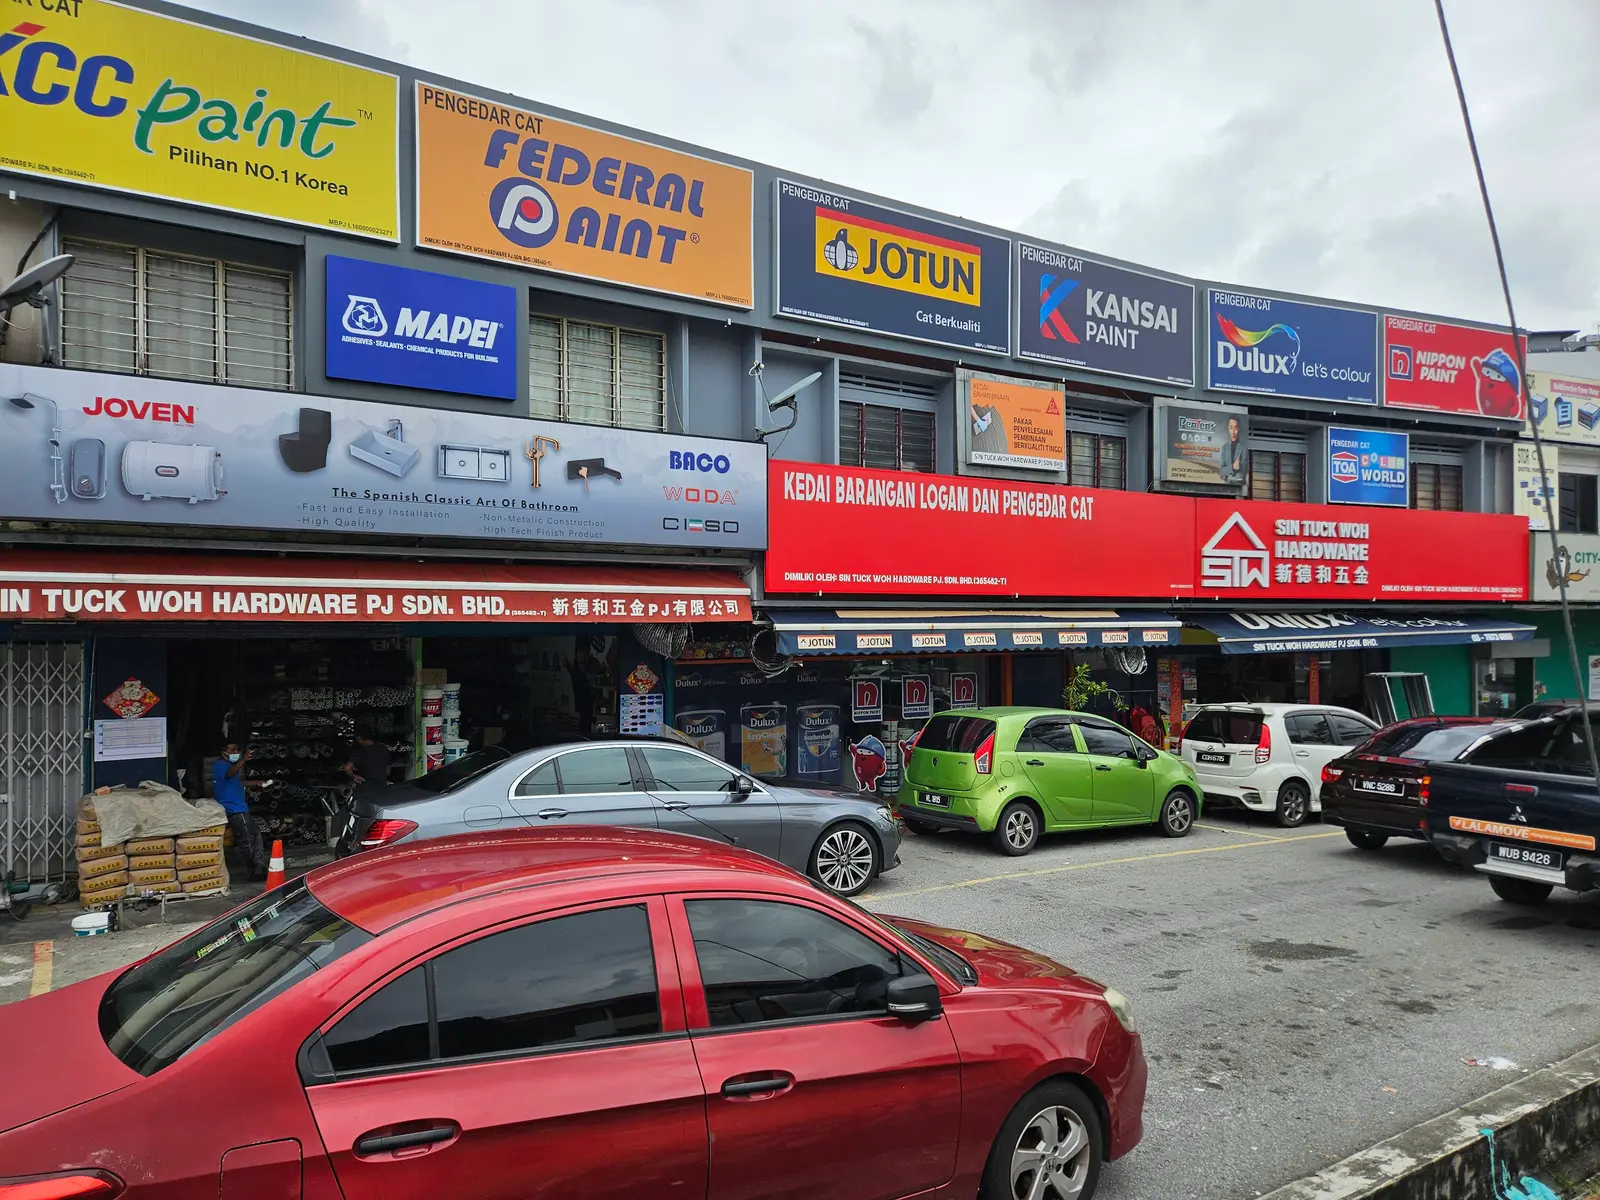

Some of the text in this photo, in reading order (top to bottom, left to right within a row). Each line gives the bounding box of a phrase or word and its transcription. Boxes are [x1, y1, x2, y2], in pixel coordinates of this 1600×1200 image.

[134, 79, 356, 158] paint
[424, 88, 543, 135] PENGEDAR CAT
[169, 145, 349, 196] Pilihan NO.1 Korea
[483, 129, 704, 218] FEDERAL
[782, 183, 850, 210] PENGEDAR CAT
[329, 219, 347, 227] MBPJ
[1022, 245, 1083, 273] PENGEDAR CAT
[863, 238, 974, 296] JOTUN
[1214, 292, 1272, 311] PENGEDAR CAT
[1086, 288, 1178, 334] KANSAI
[394, 307, 499, 349] MAPEI
[916, 310, 981, 333] Cat Berkualiti
[1388, 317, 1437, 335] PENGEDAR CAT
[1086, 320, 1139, 350] PAINT
[435, 348, 463, 359] PRODUCTS
[464, 353, 475, 361] FOR
[1416, 350, 1466, 370] NIPPON
[1216, 340, 1290, 375] Dulux
[1331, 366, 1372, 384] colour
[1420, 366, 1458, 384] PAINT
[82, 396, 195, 424] JOVEN
[1013, 417, 1033, 426] PAKAR
[1013, 426, 1053, 436] PENYELESAIAN
[1013, 434, 1046, 443] PEMBINAAN
[1331, 439, 1358, 448] PENGEDAR
[1013, 442, 1063, 454] BERKUALITI TINGGI
[669, 450, 731, 474] BACO
[1010, 457, 1037, 465] HARDWARE
[1333, 461, 1357, 474] TOA
[1361, 469, 1405, 483] WORLD
[332, 488, 579, 512] The Spanish Classic Art Of Bathroom
[663, 485, 736, 505] WODA
[784, 471, 1094, 520] KEDAI BARANGAN LOGAM DAN PENGEDAR CAT
[332, 505, 352, 514] and
[358, 506, 384, 517] Easy
[389, 508, 450, 519] Installation
[335, 517, 377, 529] Quality
[547, 517, 605, 527] Construction
[1275, 519, 1369, 539] SIN TUCK WOH
[511, 527, 532, 536] Tech
[536, 528, 564, 537] Finish
[569, 530, 603, 539] Product
[1275, 540, 1369, 561] HARDWARE
[784, 572, 814, 581] DIMILIKI
[815, 573, 837, 582] OLEH:
[839, 574, 850, 582] SIN
[852, 574, 871, 583] TUCK
[873, 574, 892, 583] WOH
[893, 575, 932, 584] HARDWARE
[1275, 563, 1369, 584] 新德和五金
[41, 589, 127, 613] TUCK
[136, 590, 202, 613] WOH
[212, 591, 357, 614] HARDWARE
[366, 593, 394, 615] PJ
[402, 594, 454, 615] SDN.
[808, 632, 1168, 648] JOTUN JOTUN JOTUN JOTUN JOTUN JOTUN JOTUN JOTUN
[1253, 637, 1378, 651] SIN TUCK WOH HARDWARE PJ SDN. BHD.
[740, 676, 762, 685] Dulux
[797, 675, 817, 683] Dulux
[686, 723, 714, 734] Dulux
[751, 717, 777, 728] Dulux
[805, 717, 829, 727] Dulux
[1462, 820, 1530, 839] LALAMOVE
[88, 847, 118, 855] CASTLE
[136, 844, 165, 852] CASTLE
[1498, 846, 1551, 865] WUB 9426
[91, 862, 120, 873] CASTLE
[139, 859, 167, 867] CASTLE
[139, 874, 169, 882] CASTLE
[188, 871, 215, 880] CASTLE
[89, 878, 119, 889] CASTLE
[193, 880, 220, 890] CASTLE
